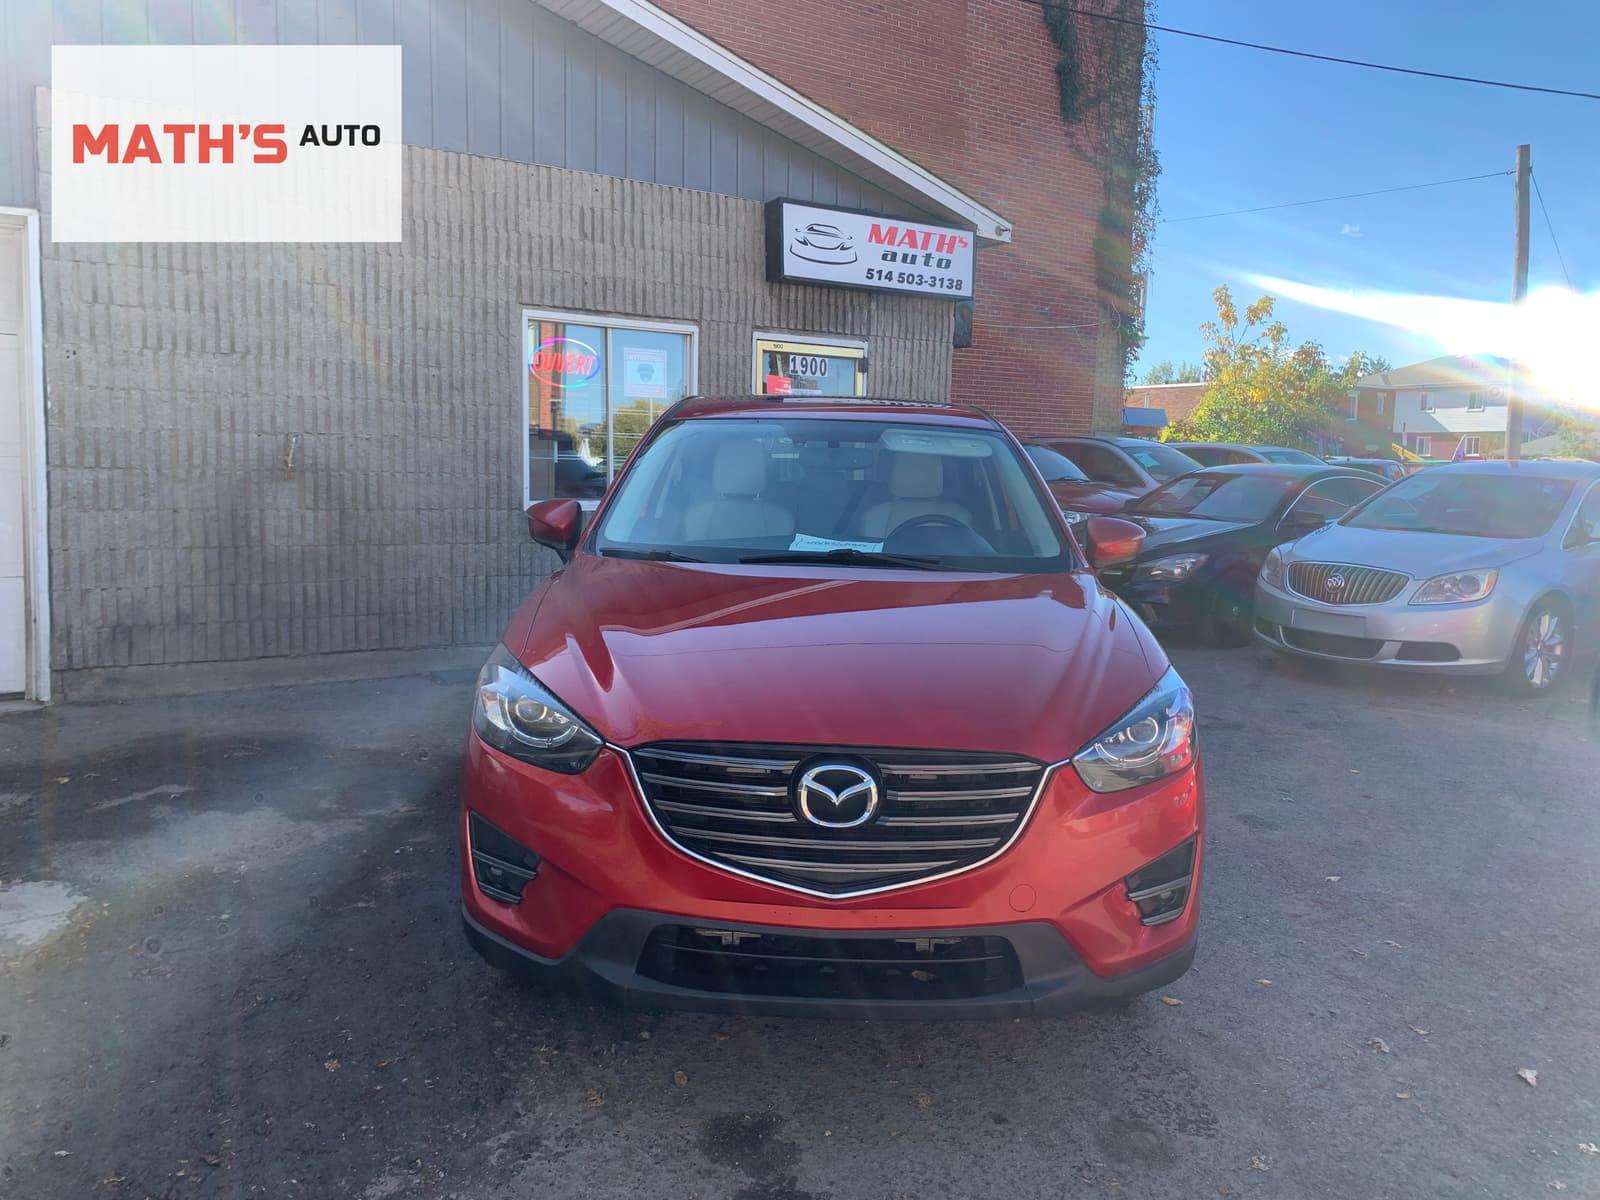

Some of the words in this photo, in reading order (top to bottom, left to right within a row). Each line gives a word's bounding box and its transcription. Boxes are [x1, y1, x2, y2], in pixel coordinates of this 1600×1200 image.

[881, 249, 952, 270] auto
[865, 268, 893, 283] 514
[897, 271, 963, 291] 503-3138
[532, 351, 596, 376] OUVERT
[790, 355, 828, 377] 1900
